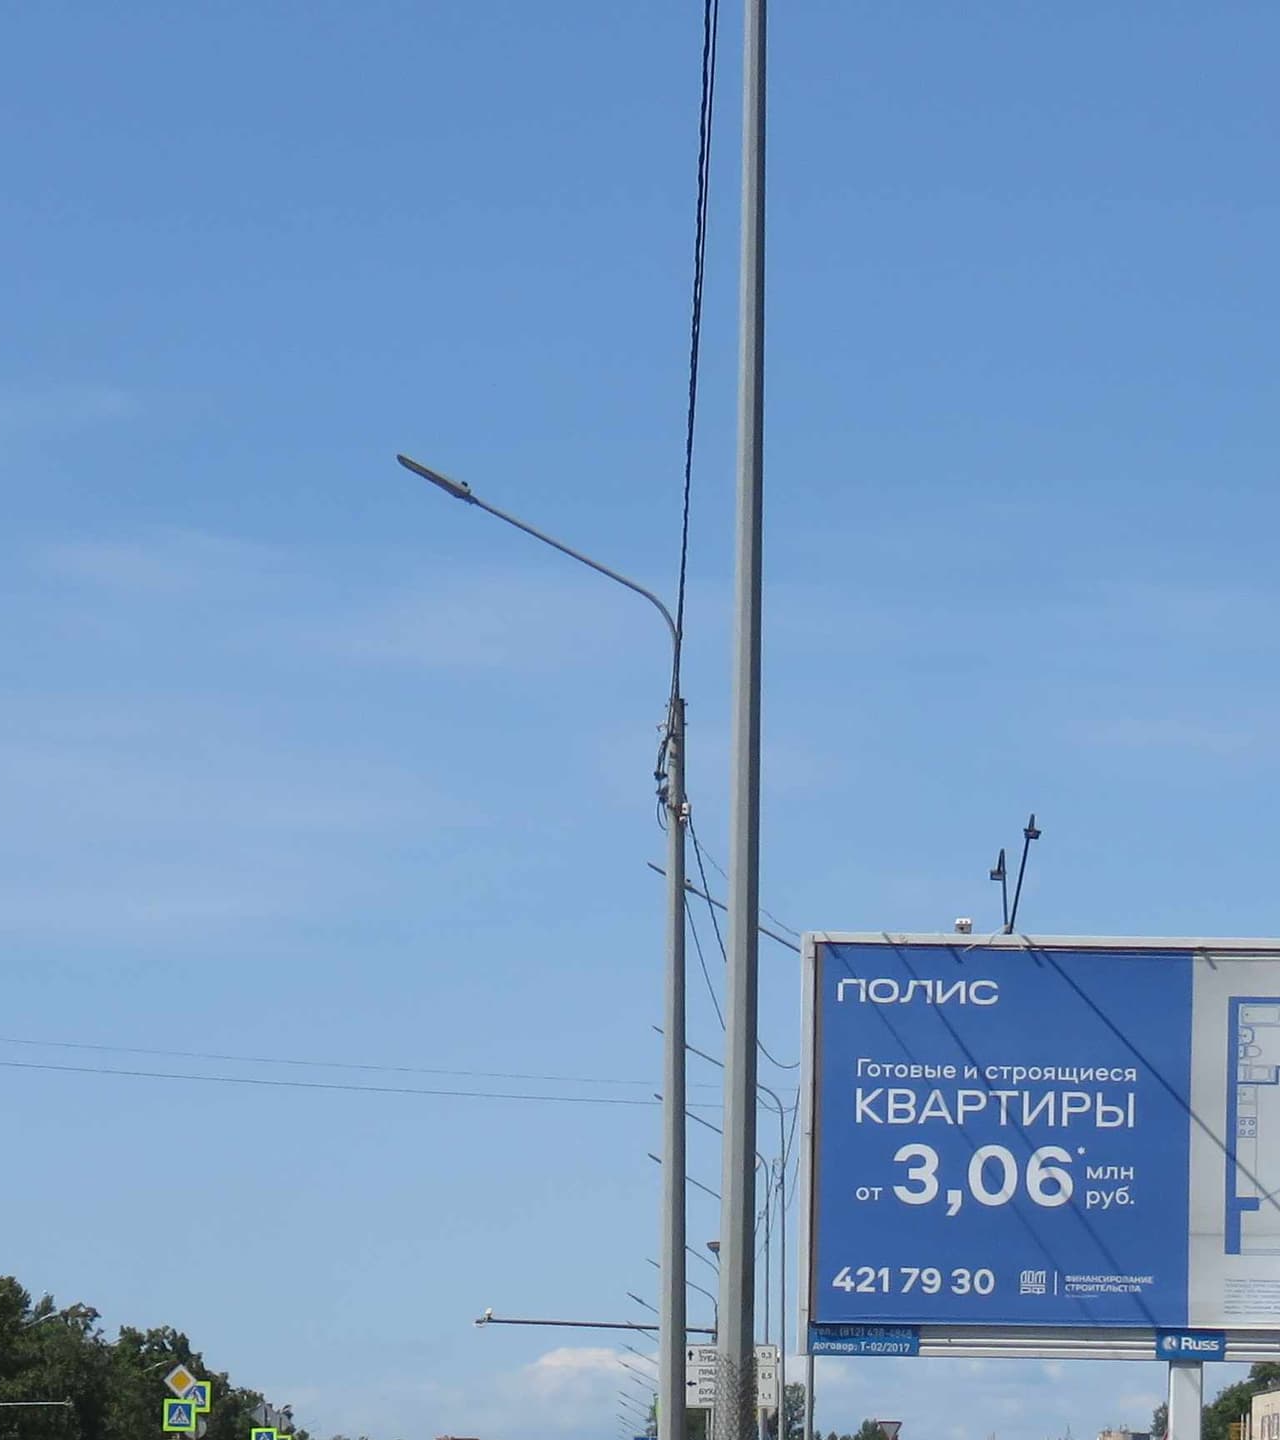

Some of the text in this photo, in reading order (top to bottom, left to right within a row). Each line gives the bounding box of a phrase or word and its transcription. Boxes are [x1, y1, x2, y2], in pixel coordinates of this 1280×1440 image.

[837, 978, 999, 1005] ПОЛИС
[857, 1058, 1137, 1084] Готовые и строящиеся
[855, 1087, 1136, 1128] КВАРТИРЫ
[855, 1186, 883, 1201] от
[1086, 1166, 1134, 1180] млн
[1086, 1187, 1135, 1209] руб.
[832, 1266, 995, 1295] 421 79 30
[1065, 1283, 1142, 1292] СТРОИТЕЛЬСТВА
[1180, 1337, 1220, 1351] Russ
